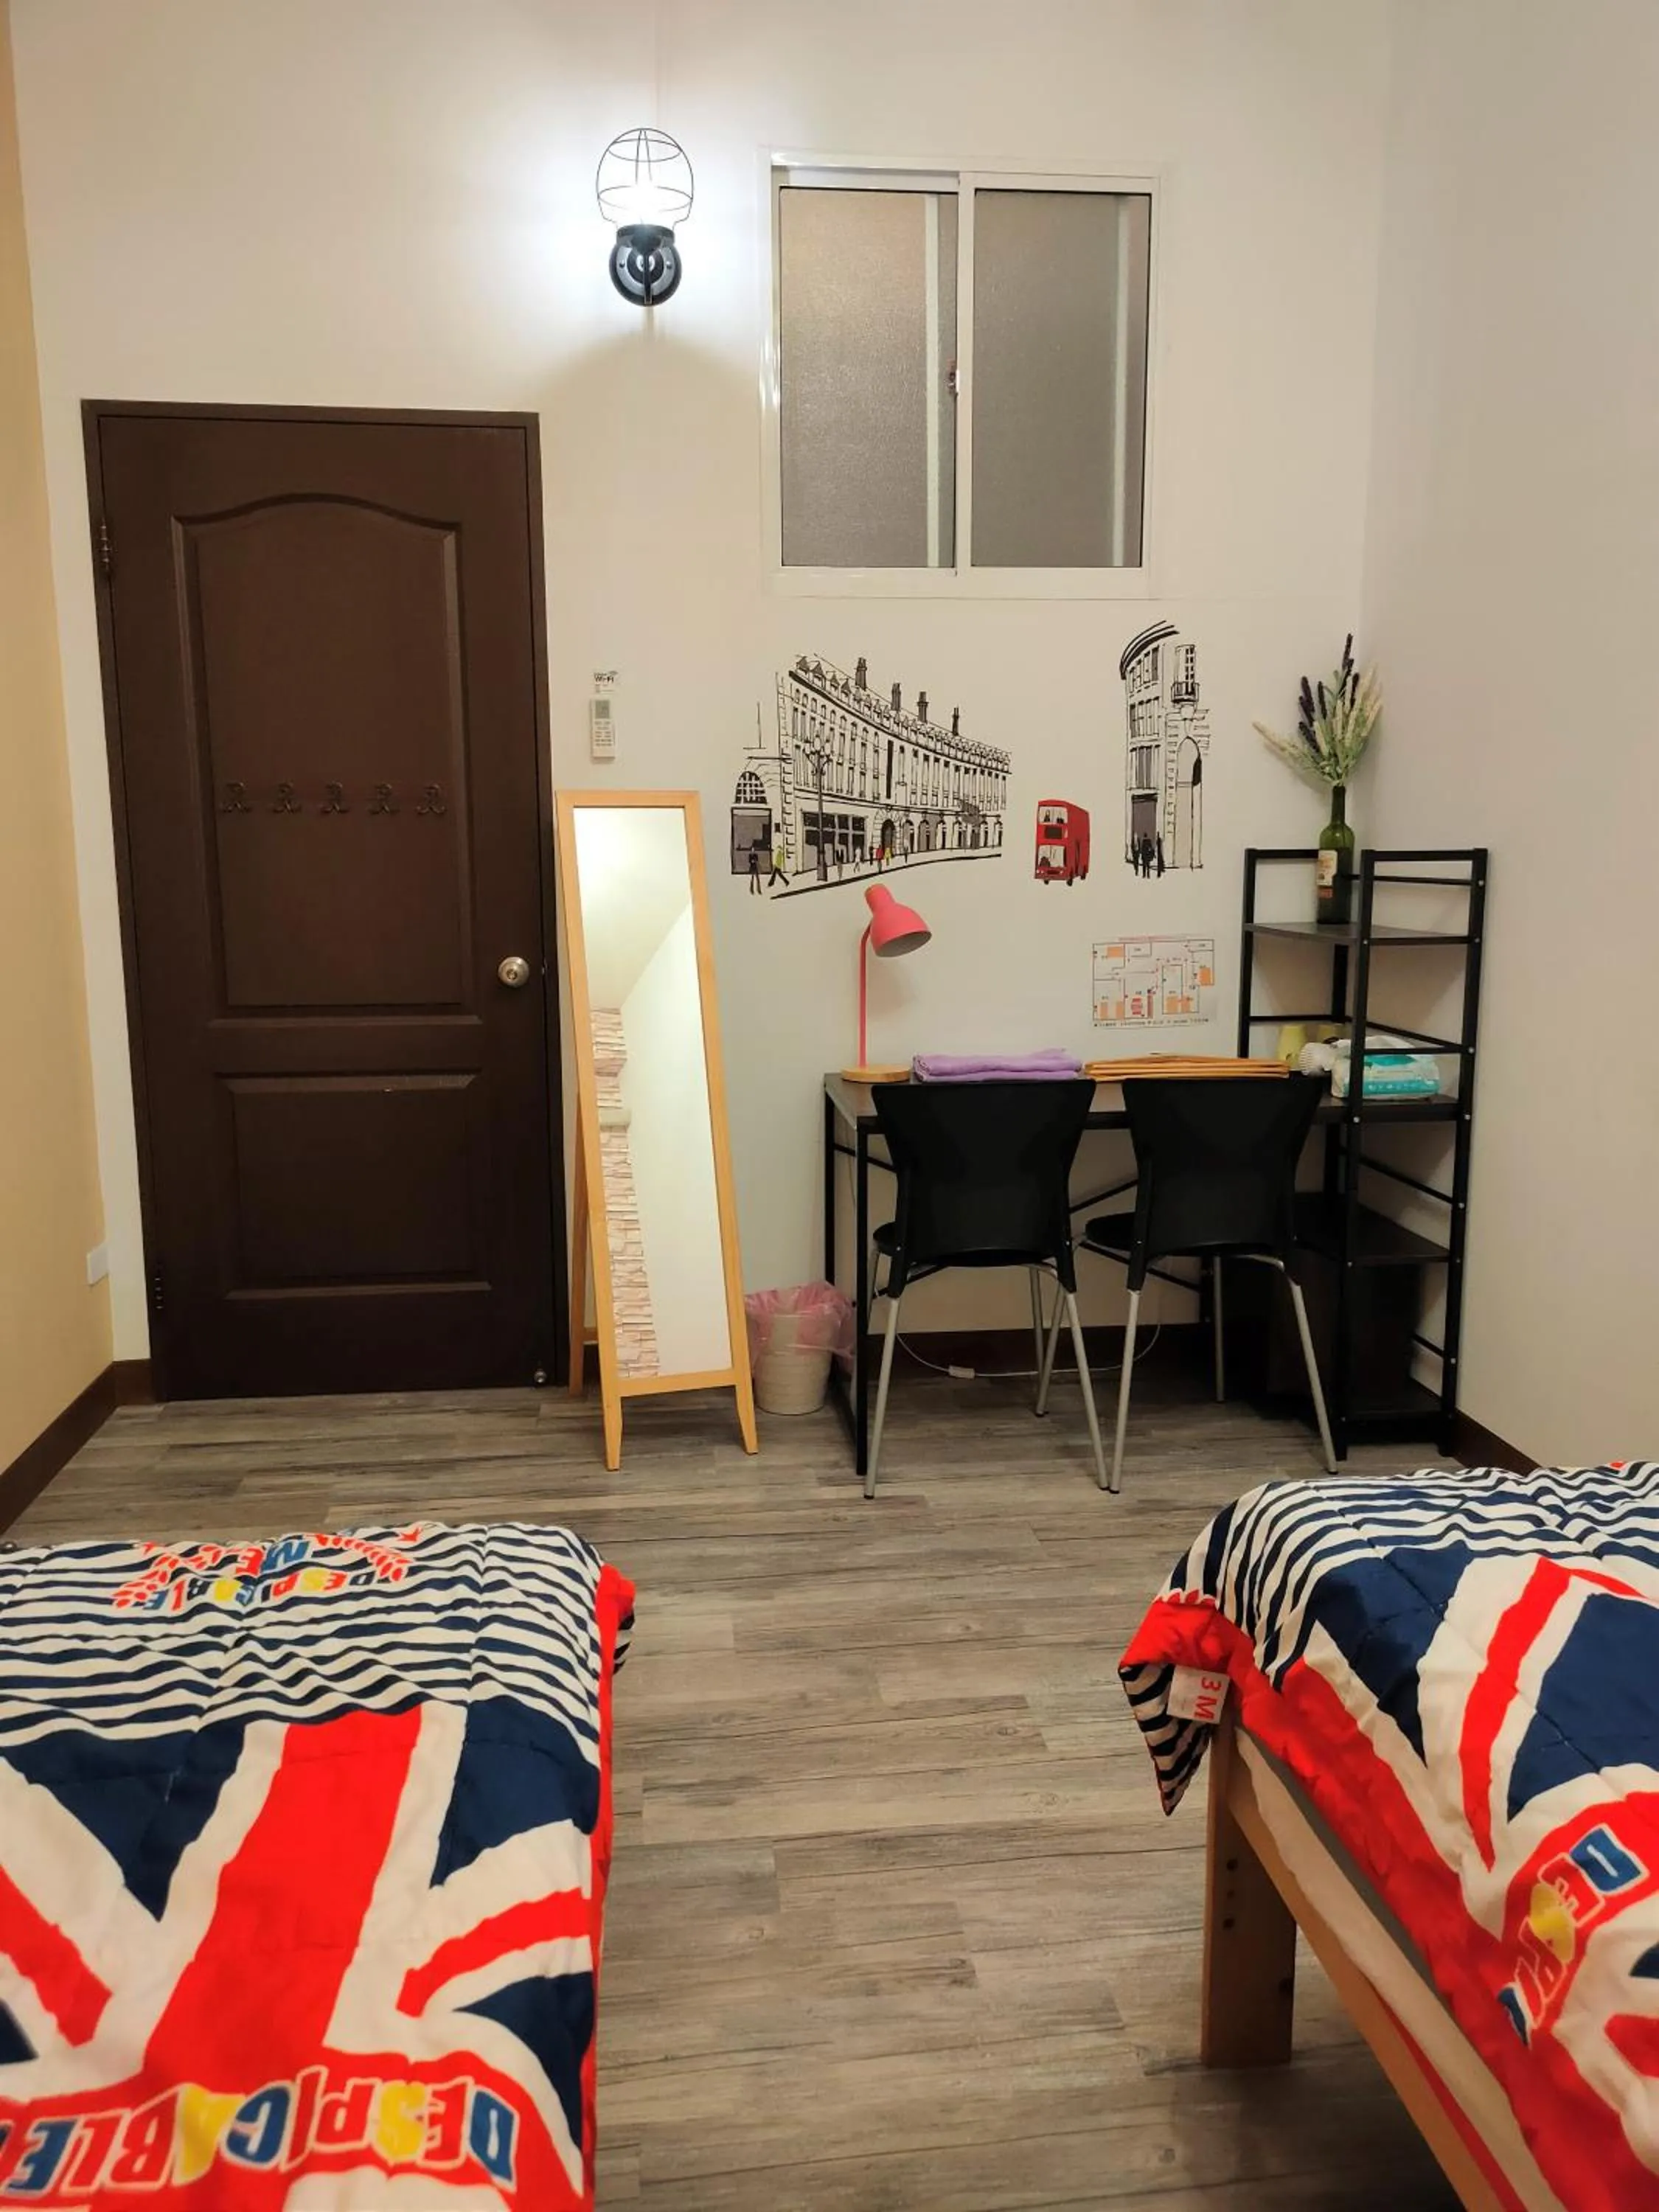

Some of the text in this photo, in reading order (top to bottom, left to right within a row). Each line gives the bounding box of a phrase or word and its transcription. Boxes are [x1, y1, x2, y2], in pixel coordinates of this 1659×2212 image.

[235, 1540, 310, 1576] ME
[1194, 1676, 1222, 1721] 3M
[4, 2067, 517, 2193] DESPICABLE
